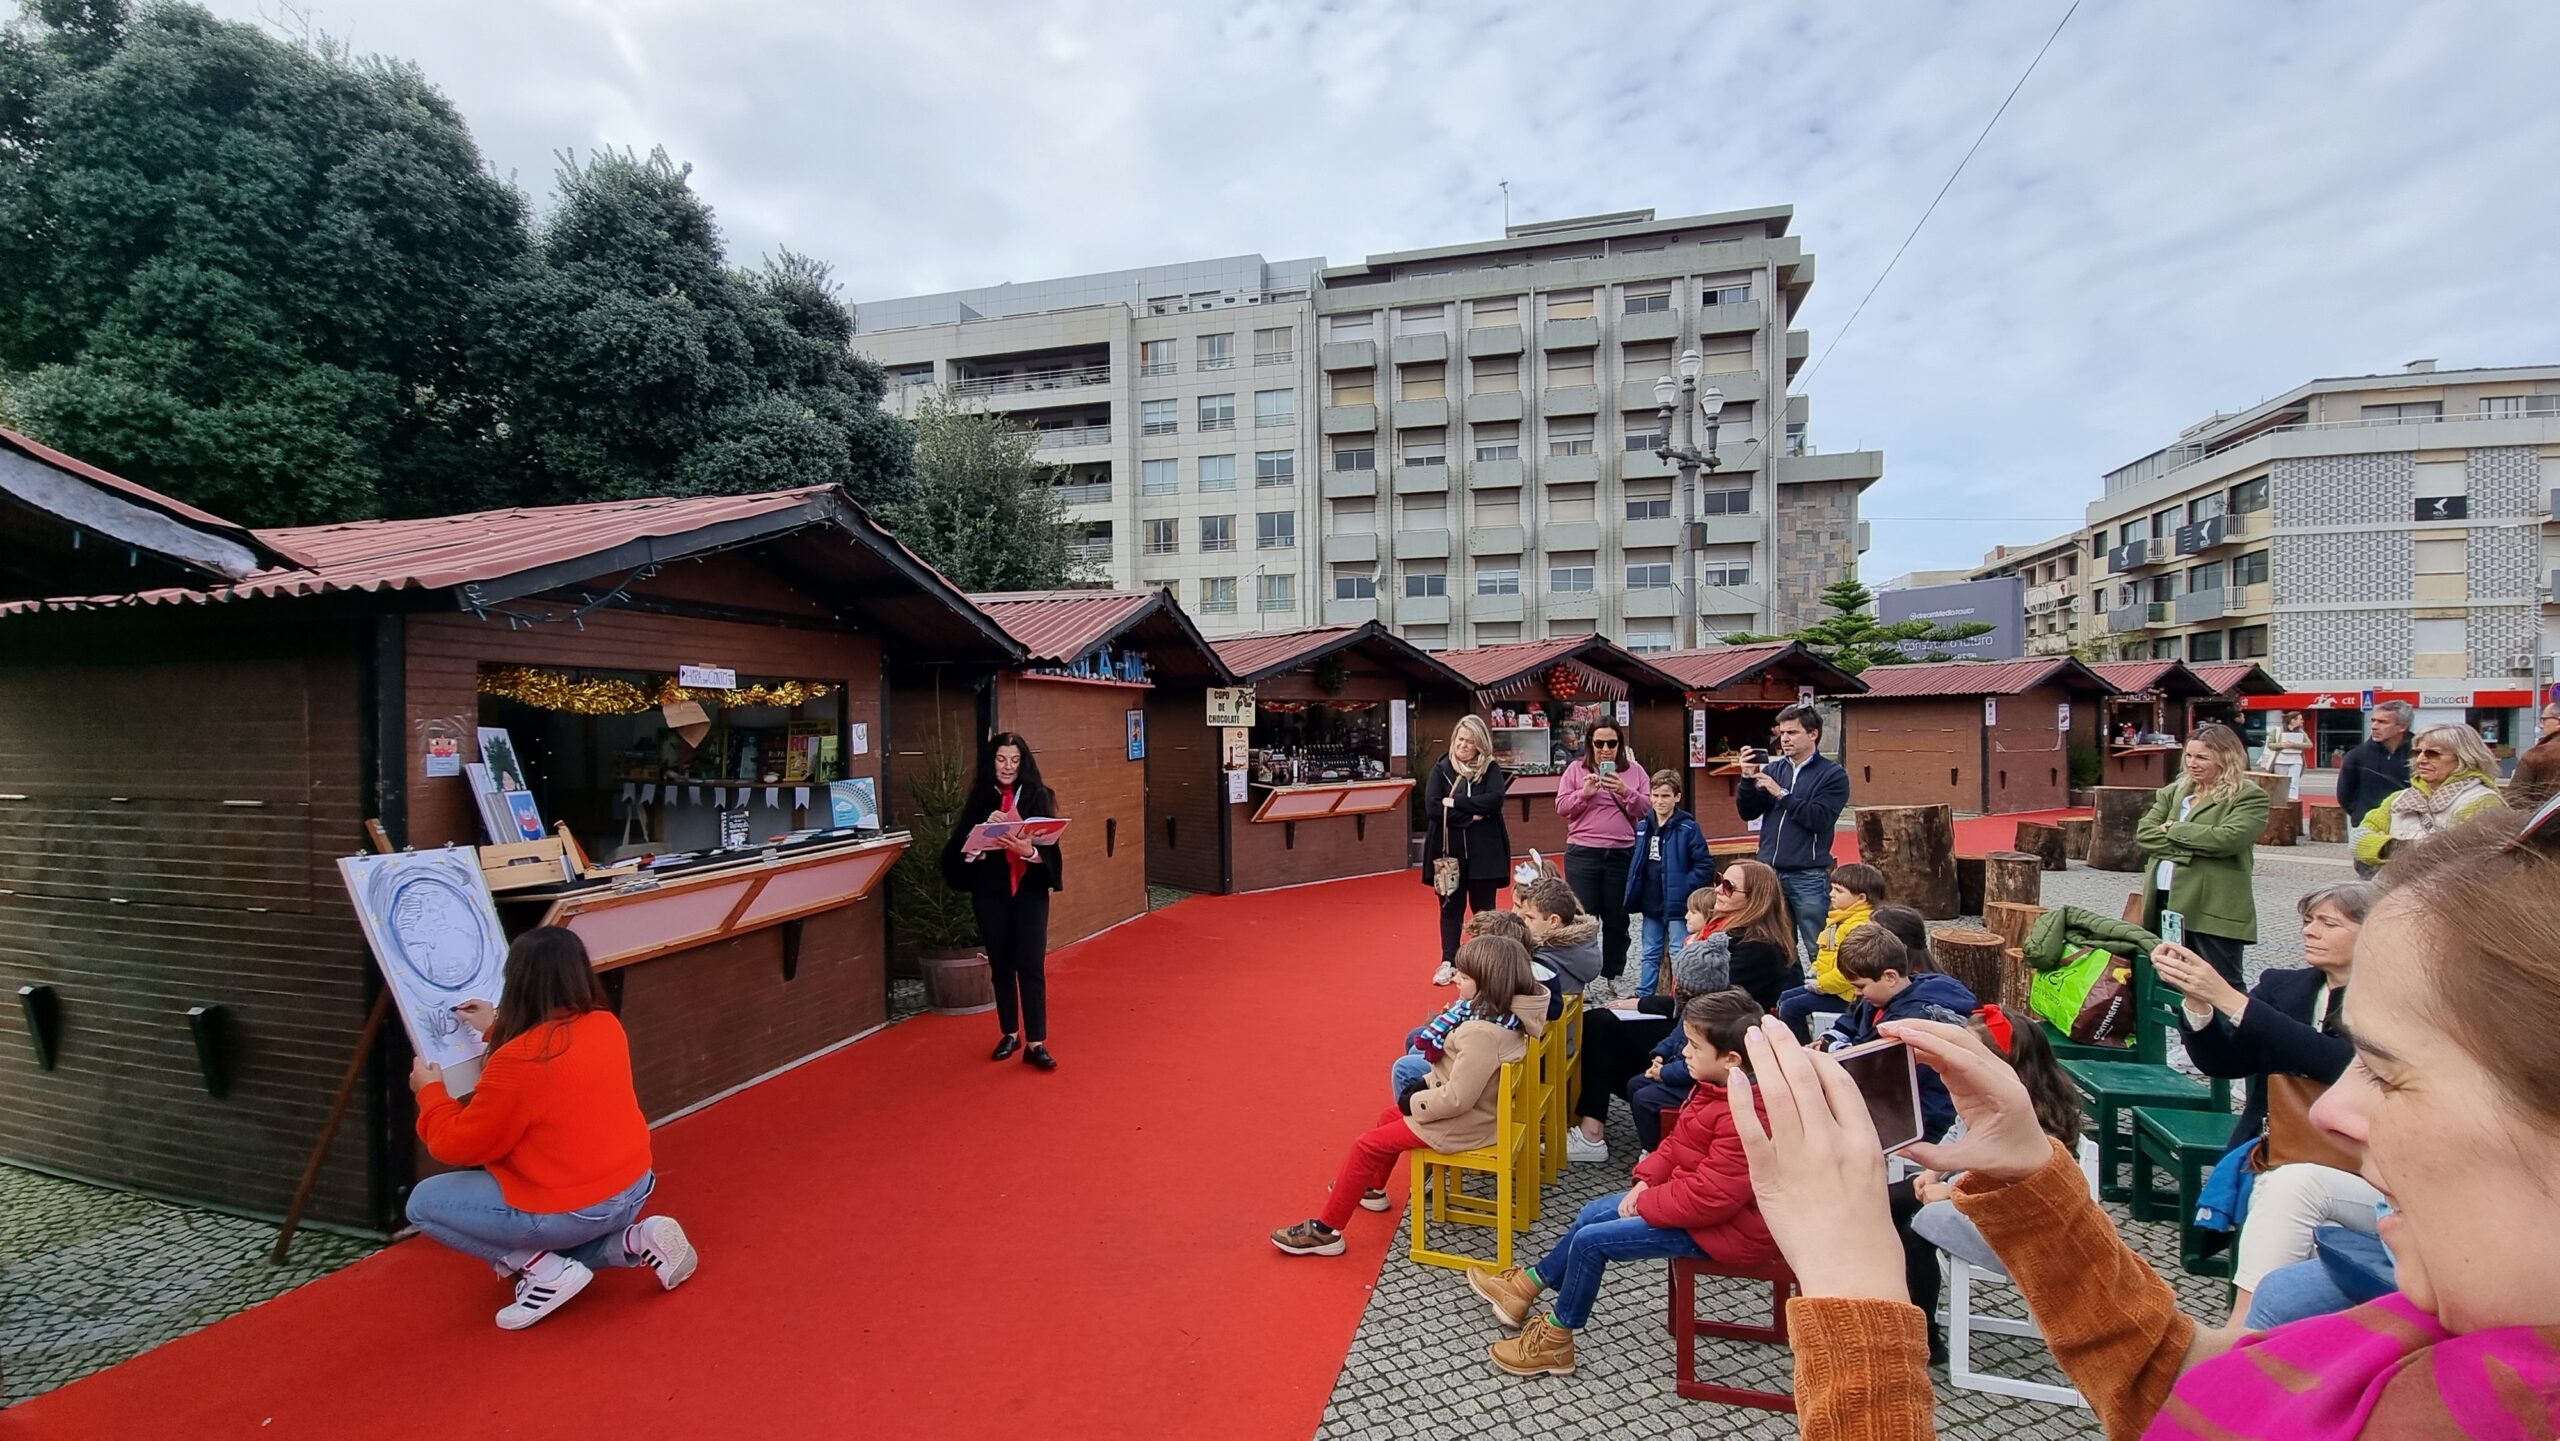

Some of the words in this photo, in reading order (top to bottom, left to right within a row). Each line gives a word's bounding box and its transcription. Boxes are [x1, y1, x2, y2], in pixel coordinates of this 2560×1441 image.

[1214, 690, 1230, 700] COPO
[2341, 696, 2356, 705] ctt
[1218, 702, 1225, 712] DE
[1208, 714, 1240, 724] CHOCOLATE
[791, 736, 809, 752] RO
[2093, 995, 2123, 1040] CONTINENTE
